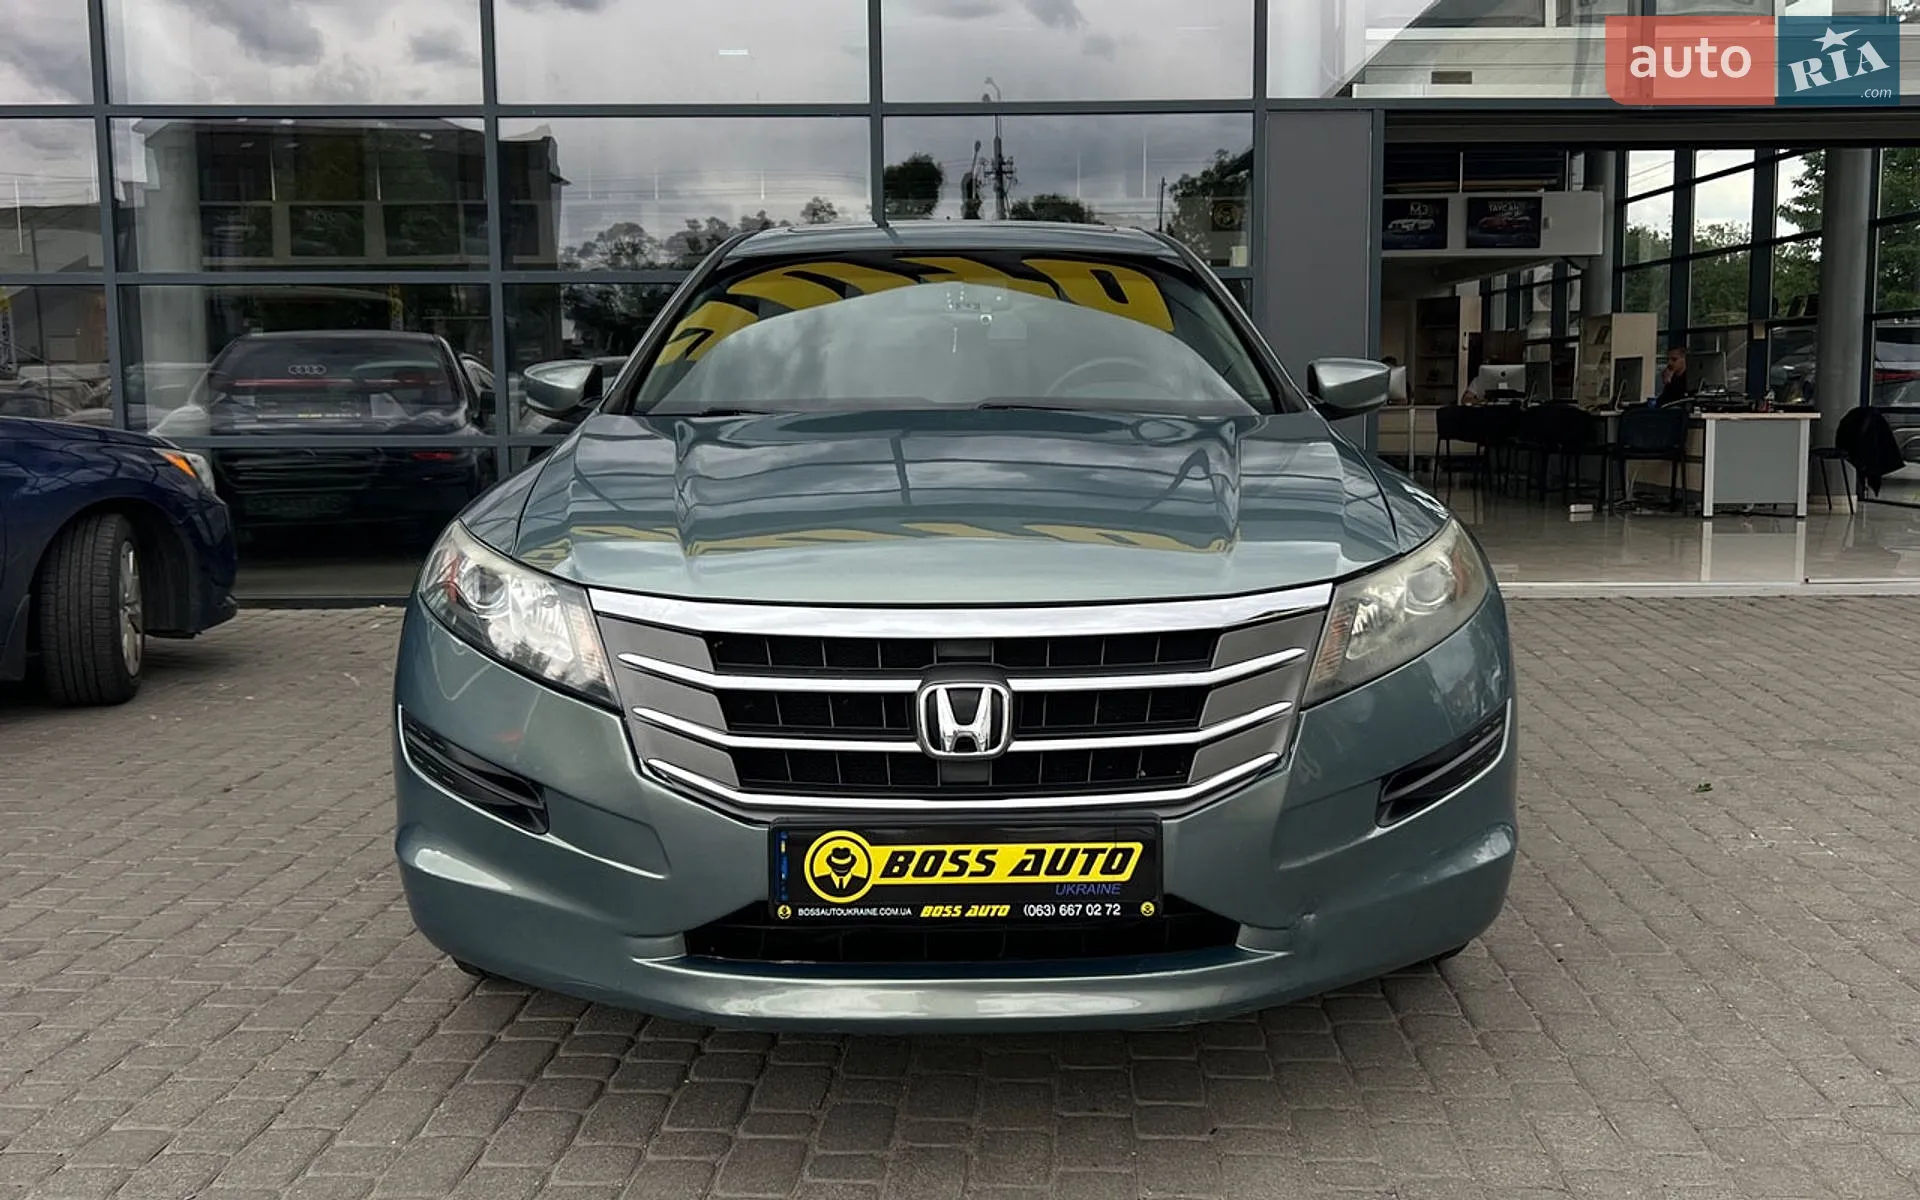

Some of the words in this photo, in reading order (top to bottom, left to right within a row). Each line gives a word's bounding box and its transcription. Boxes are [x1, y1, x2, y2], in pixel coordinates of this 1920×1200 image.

[879, 848, 999, 878] BOSS
[1008, 847, 1137, 877] AUTO
[1055, 883, 1121, 896] UKRAINE
[798, 906, 912, 917] BOSSAUTOUKRAINE.COM.UA
[920, 905, 961, 917] BOSS
[965, 904, 1011, 917] AUTO
[1023, 904, 1056, 917] (063)
[1059, 904, 1083, 917] 667
[1085, 904, 1102, 916] 02
[1104, 904, 1121, 916] 72
